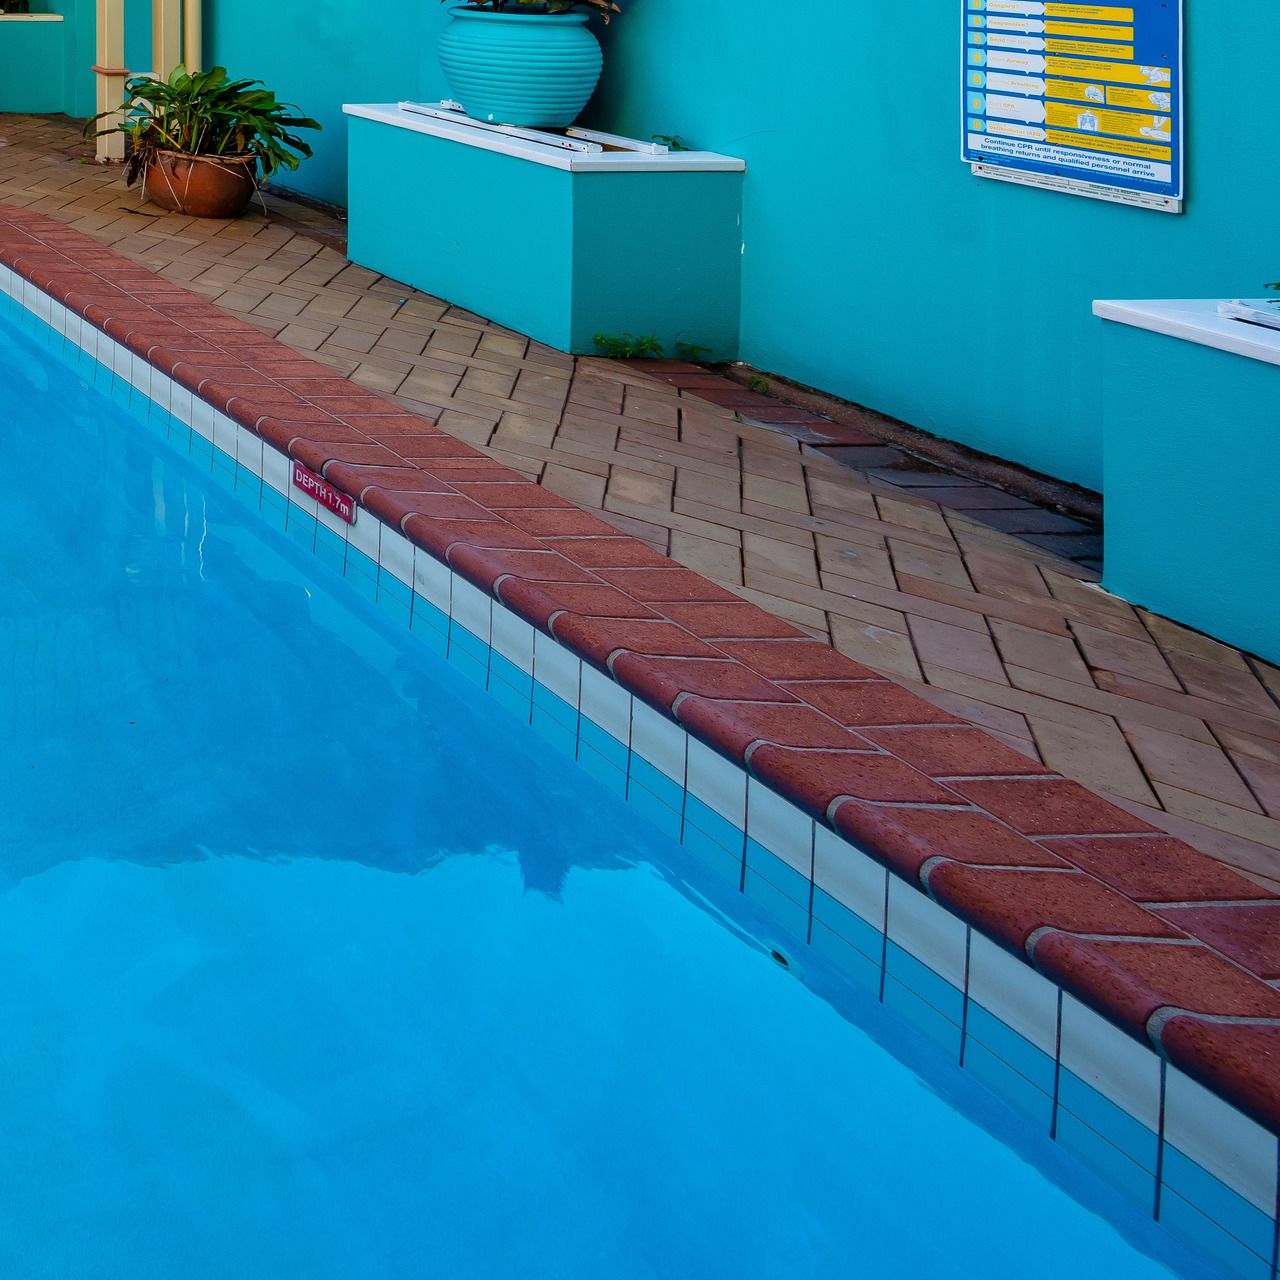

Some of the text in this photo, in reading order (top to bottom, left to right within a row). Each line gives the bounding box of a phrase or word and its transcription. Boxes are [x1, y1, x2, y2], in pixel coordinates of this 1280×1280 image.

[980, 143, 1014, 155] breathing
[1015, 150, 1041, 159] returns
[1058, 157, 1090, 167] qualified
[1091, 162, 1130, 173] personnel
[1132, 169, 1156, 178] arrive
[984, 137, 1016, 148] Continue
[1017, 142, 1033, 150] CPR
[1052, 149, 1111, 163] responsiveness
[1122, 160, 1151, 170] normal
[295, 469, 349, 517] DEPTH 1.7m
